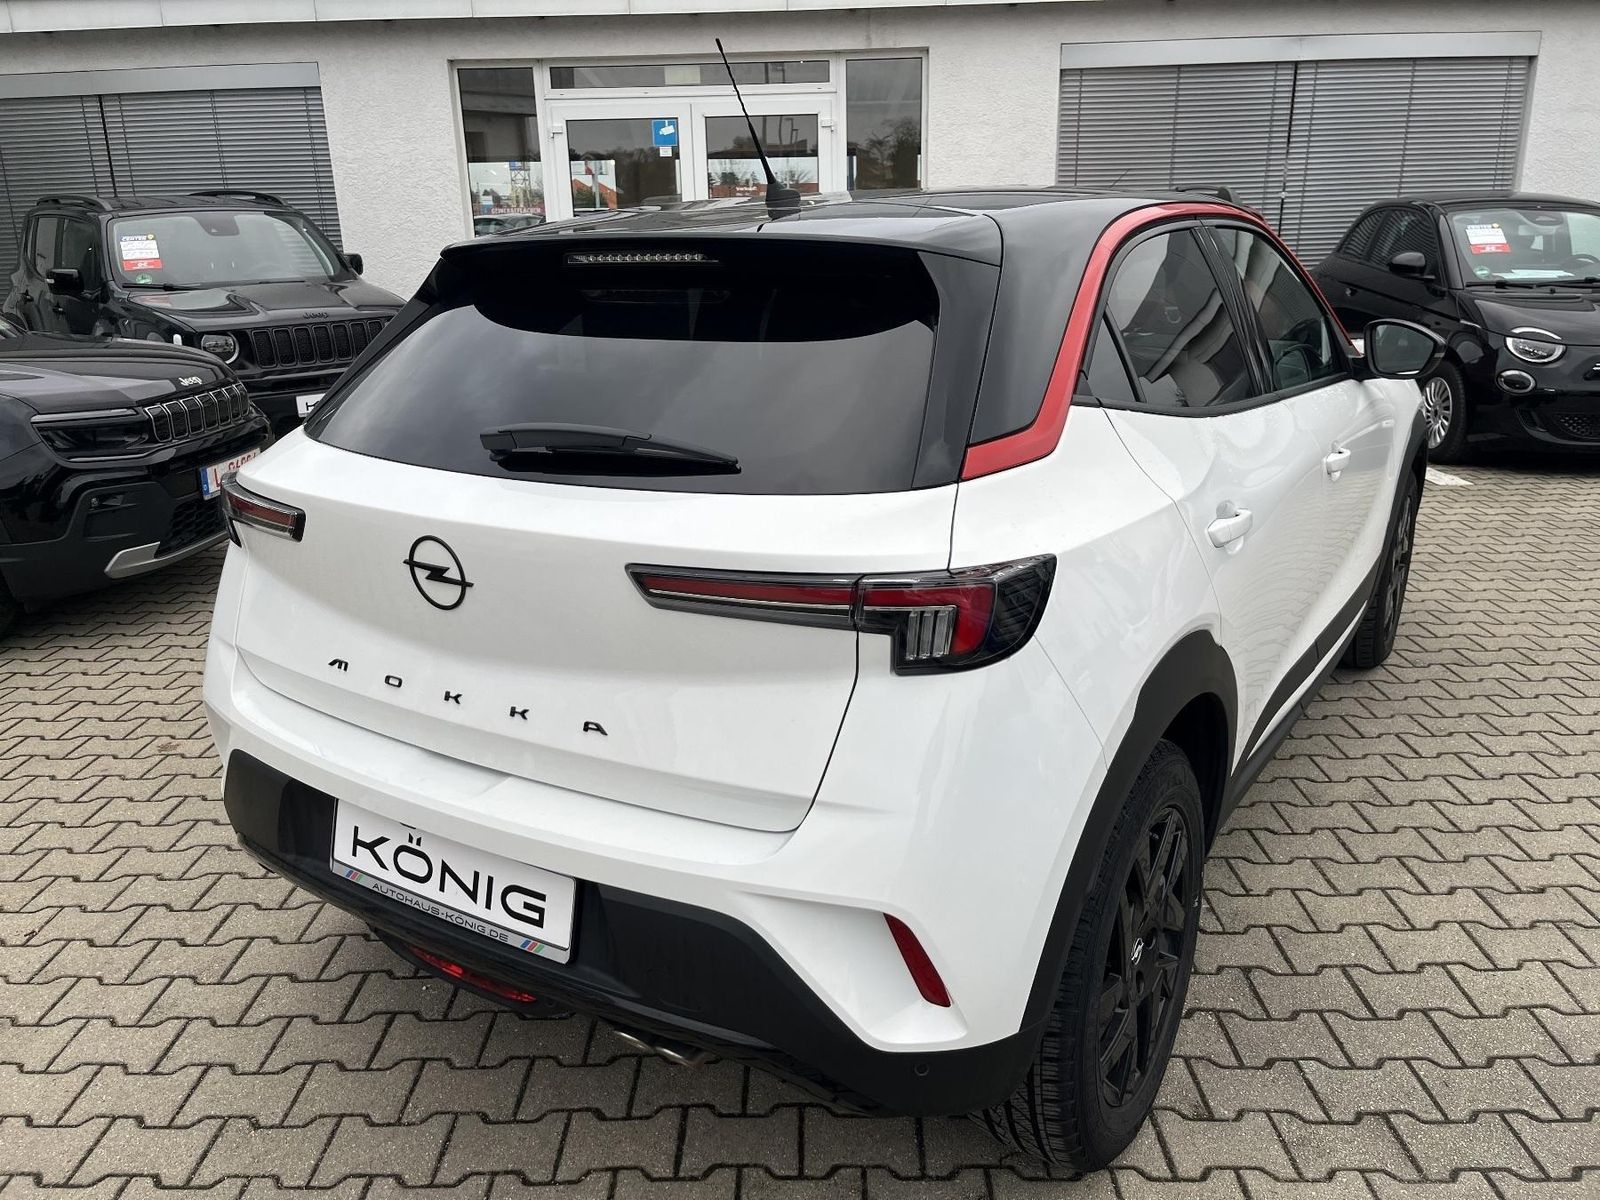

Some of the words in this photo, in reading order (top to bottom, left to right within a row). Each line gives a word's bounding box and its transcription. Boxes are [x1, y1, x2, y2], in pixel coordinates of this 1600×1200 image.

[178, 376, 203, 387] Jeep
[328, 658, 608, 736] MOKKA
[351, 825, 547, 929] KÖNIG
[372, 882, 510, 943] AUTOHAUS-KÖNIG.DE
